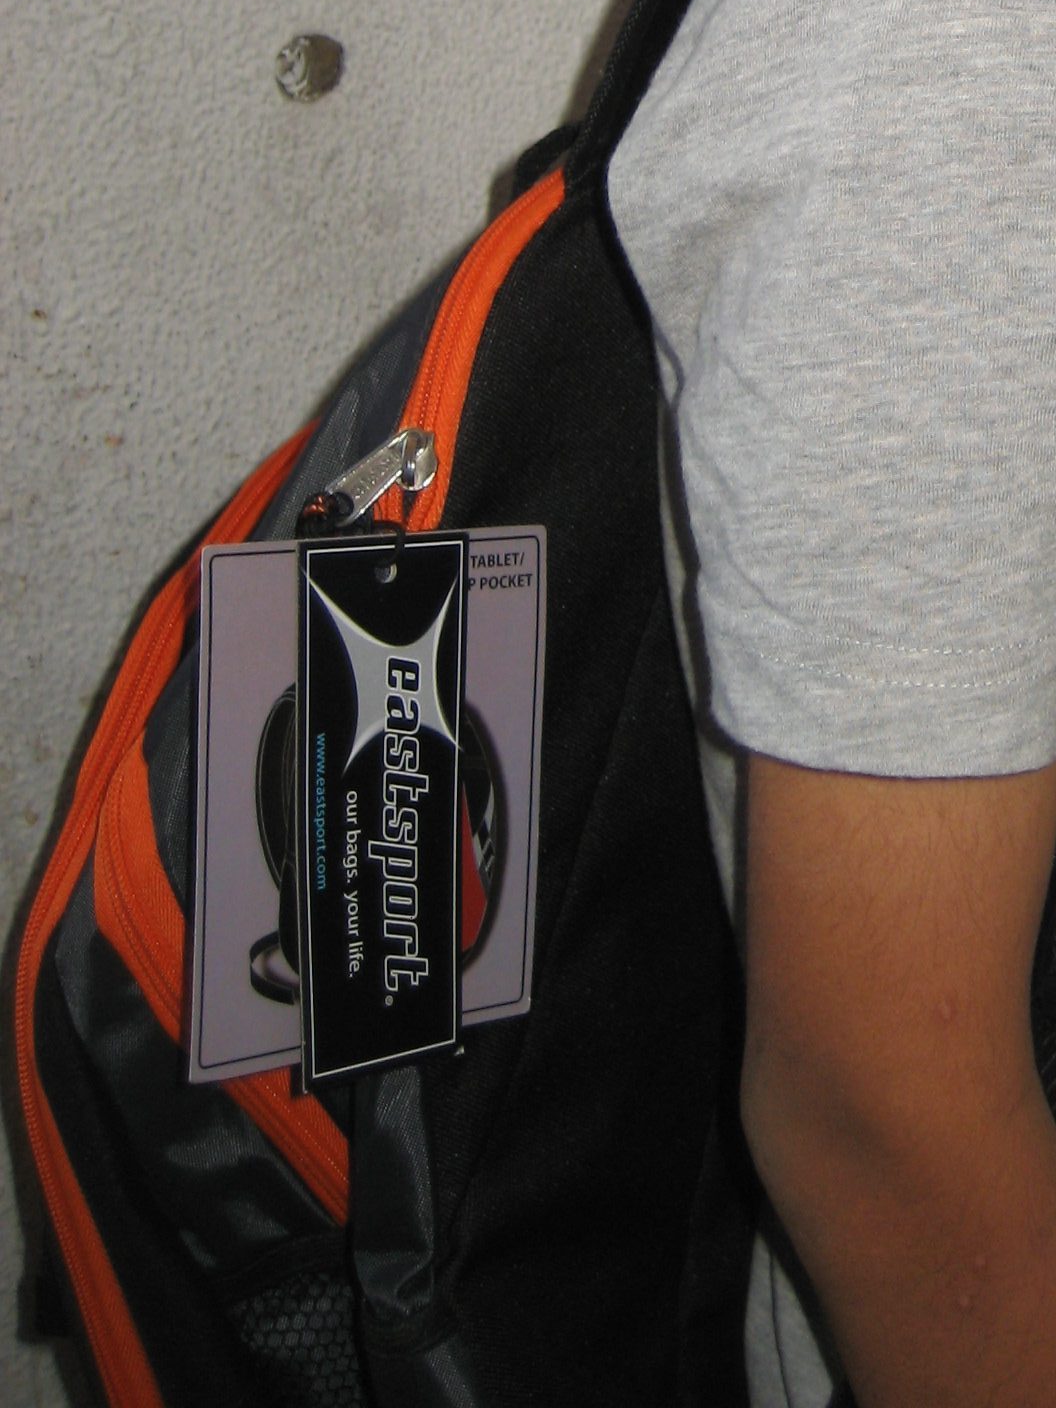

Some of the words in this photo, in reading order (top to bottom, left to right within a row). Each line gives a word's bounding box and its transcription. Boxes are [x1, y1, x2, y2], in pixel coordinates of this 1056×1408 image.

[470, 552, 525, 569] TABLET/
[480, 574, 532, 590] POCKET
[314, 732, 327, 891] www.eastsport.com
[346, 791, 358, 825] our
[368, 655, 429, 992] eastsport
[343, 830, 361, 884] bags.
[344, 890, 360, 936] your
[348, 941, 364, 978] life.
